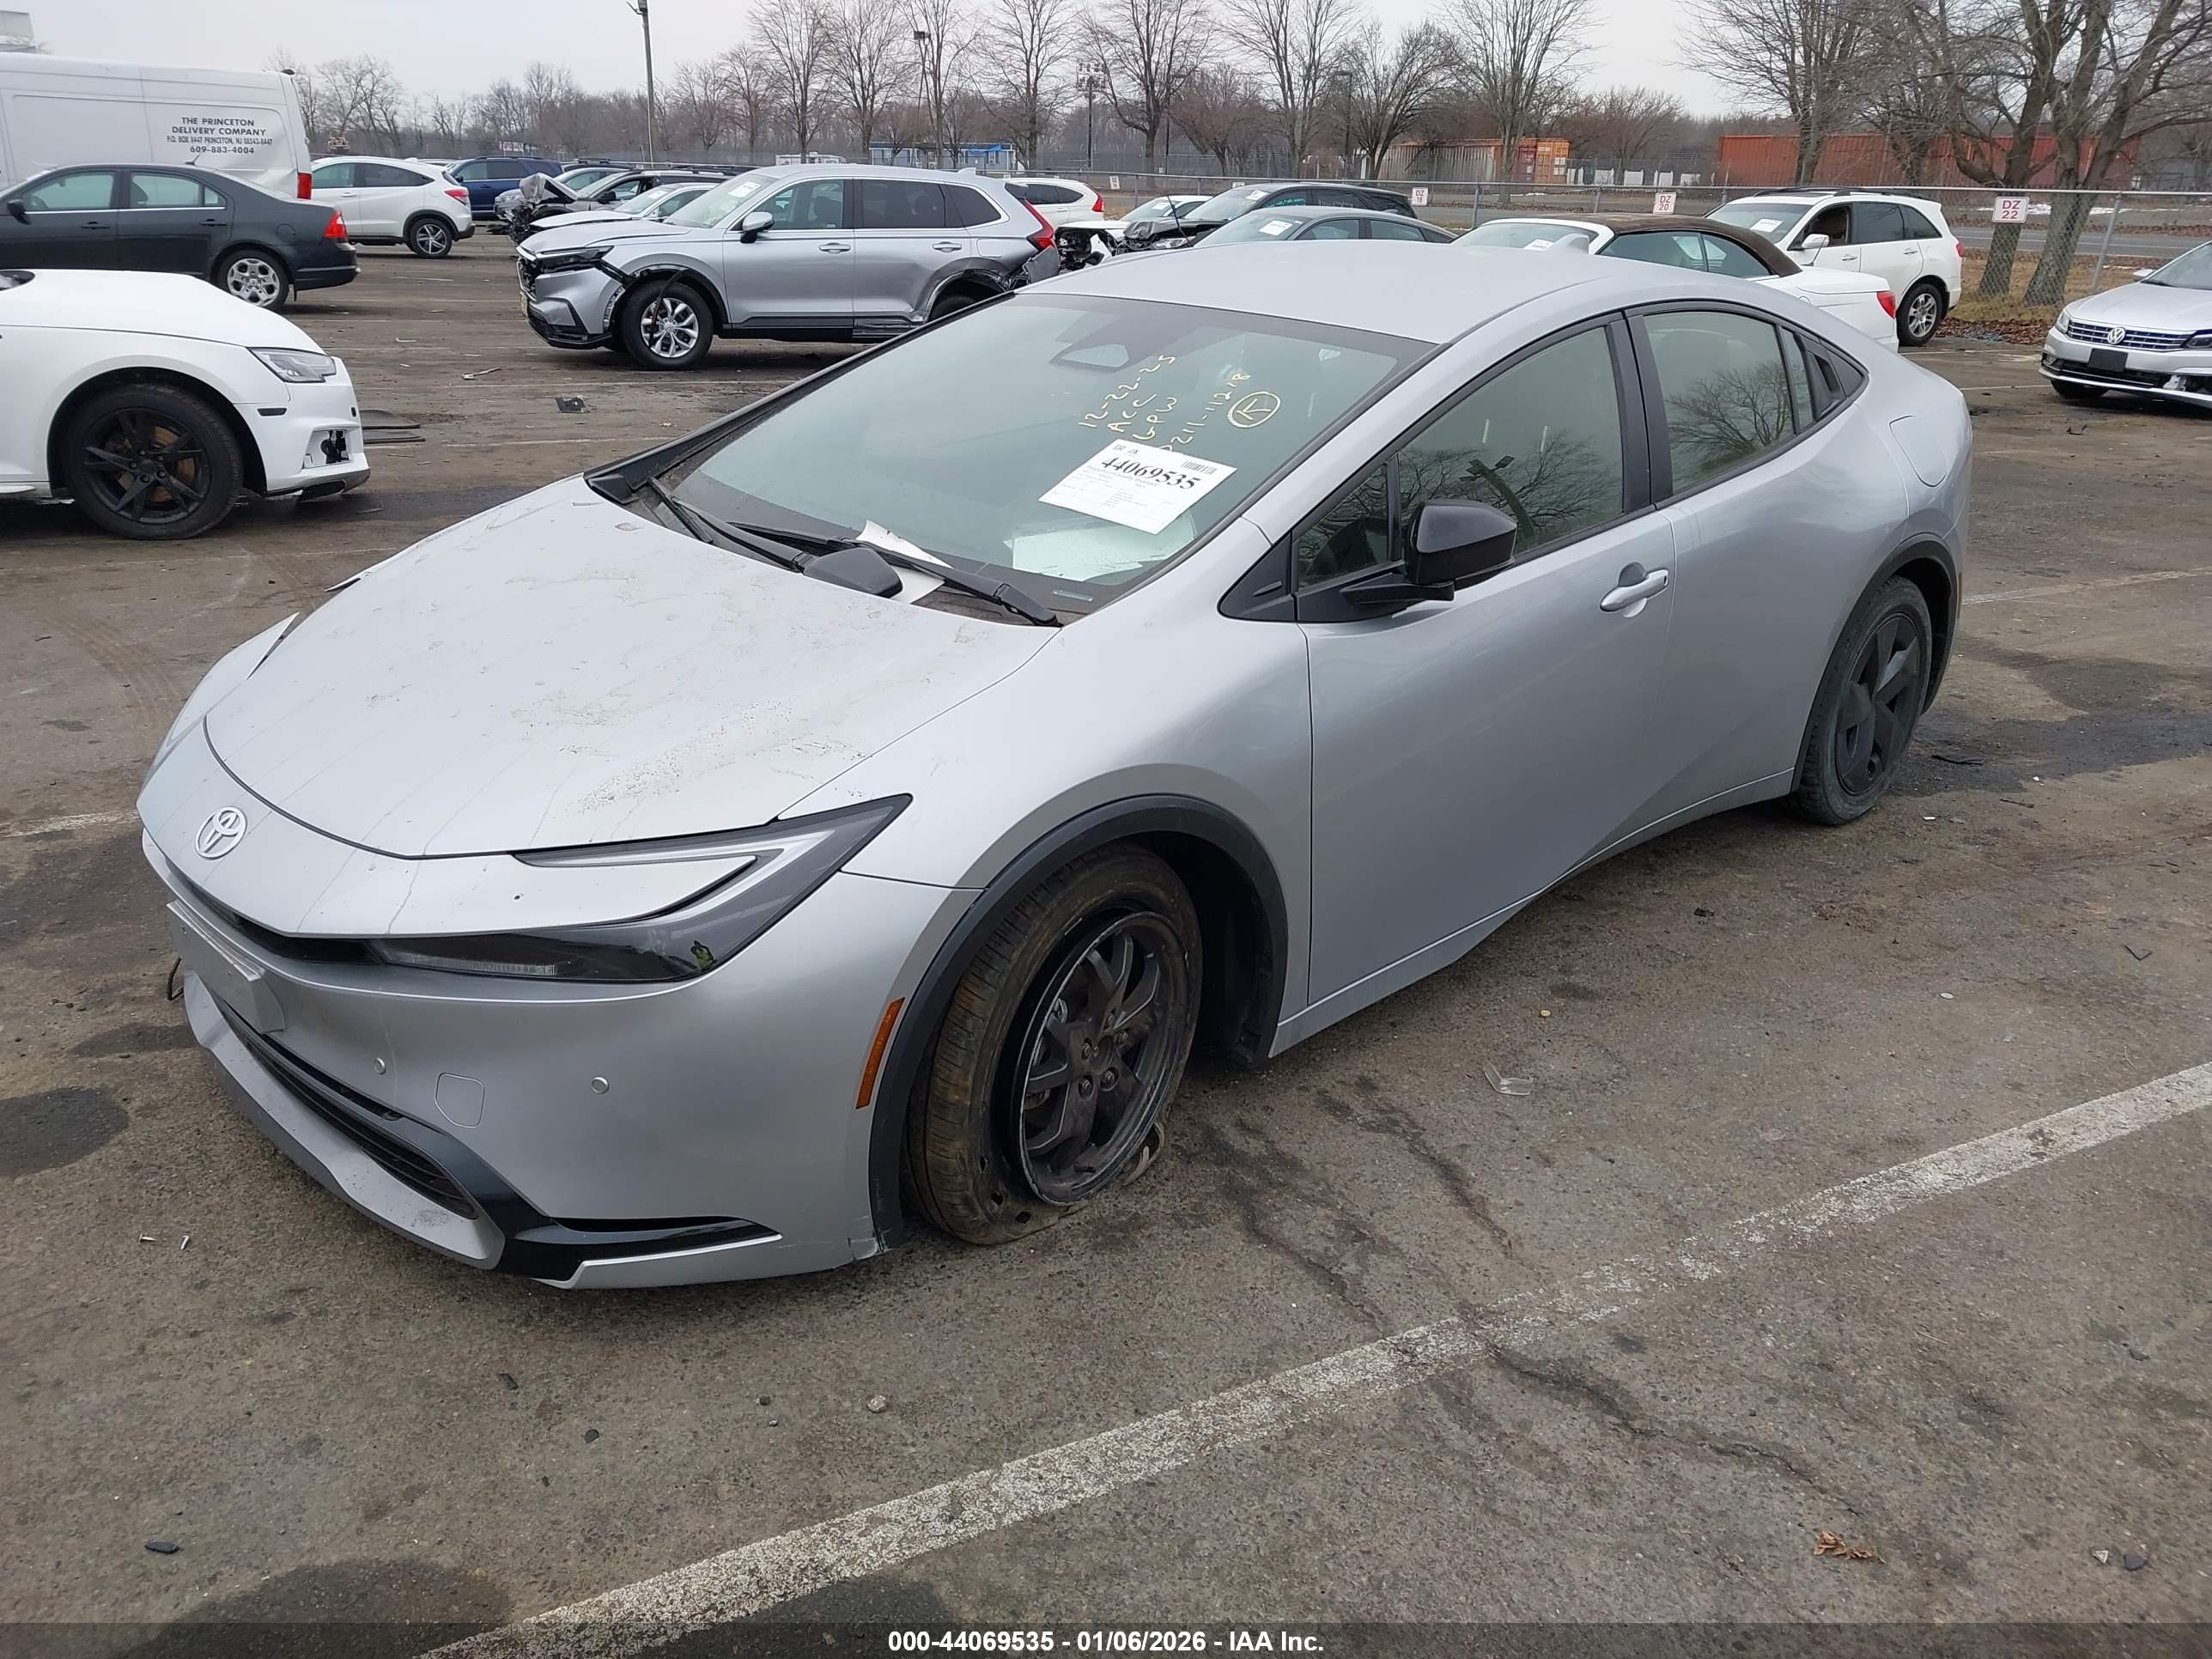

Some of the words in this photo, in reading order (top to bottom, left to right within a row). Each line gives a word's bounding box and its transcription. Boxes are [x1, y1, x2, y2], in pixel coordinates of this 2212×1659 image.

[202, 117, 255, 126] PRINCETON
[218, 127, 267, 136] COMPANY
[2002, 200, 2021, 209] DZ
[2002, 210, 2019, 219] 22
[1107, 393, 1158, 433] ACC
[1101, 457, 1202, 489] 44069535
